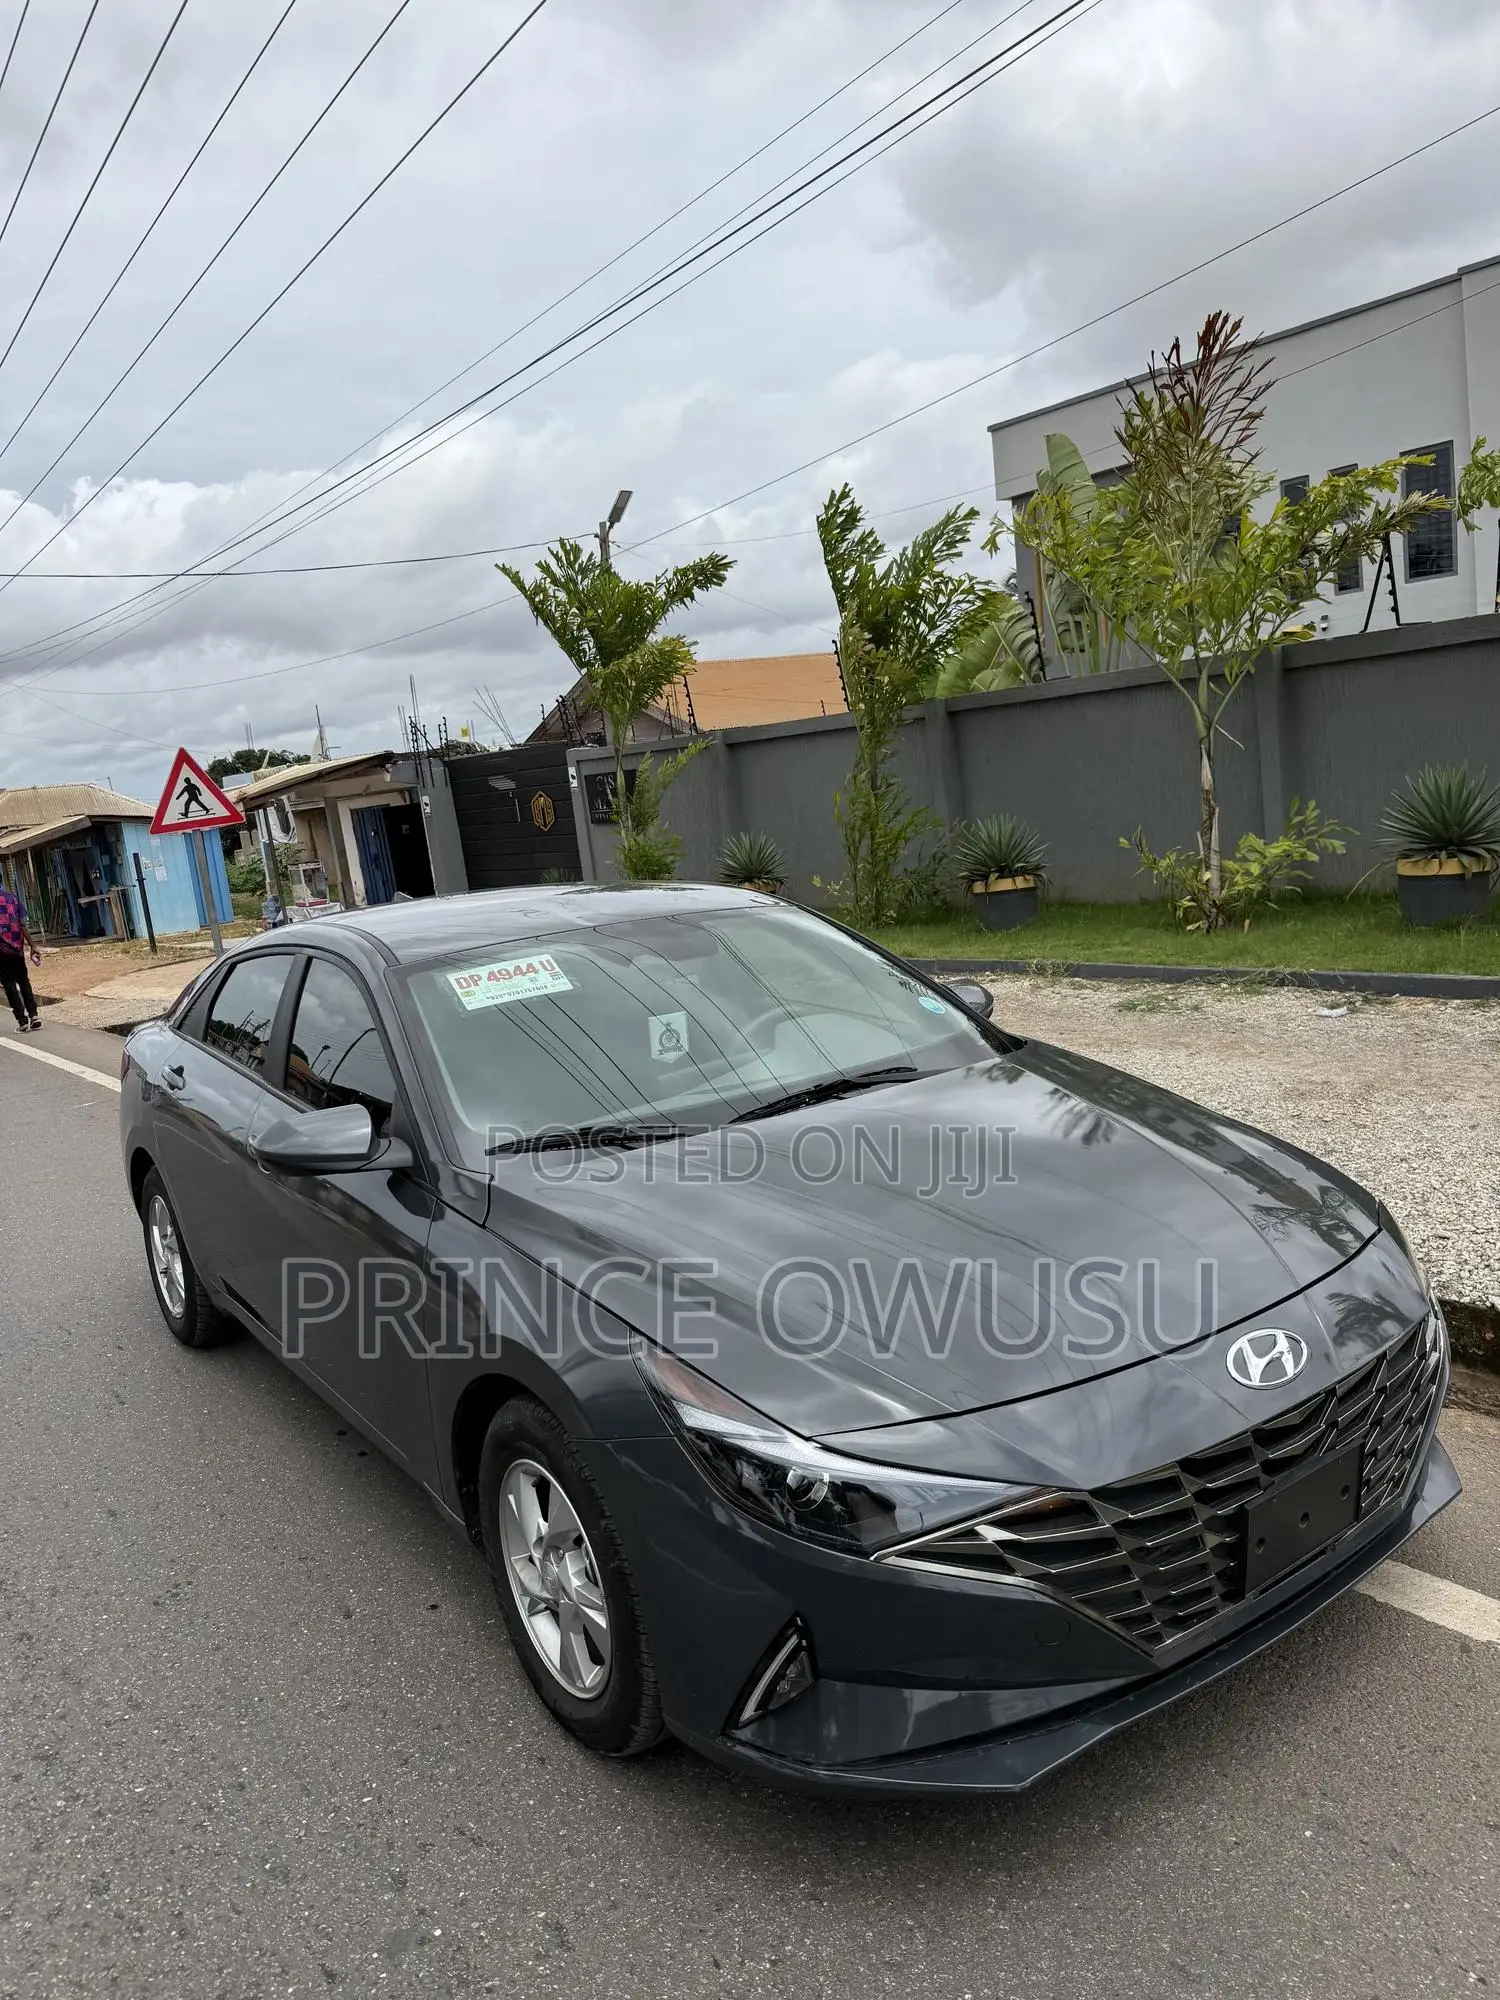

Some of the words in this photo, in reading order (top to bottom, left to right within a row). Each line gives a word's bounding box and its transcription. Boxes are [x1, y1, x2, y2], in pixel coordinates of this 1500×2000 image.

[454, 974, 482, 990] DP
[487, 962, 539, 983] 4944
[538, 959, 556, 972] U
